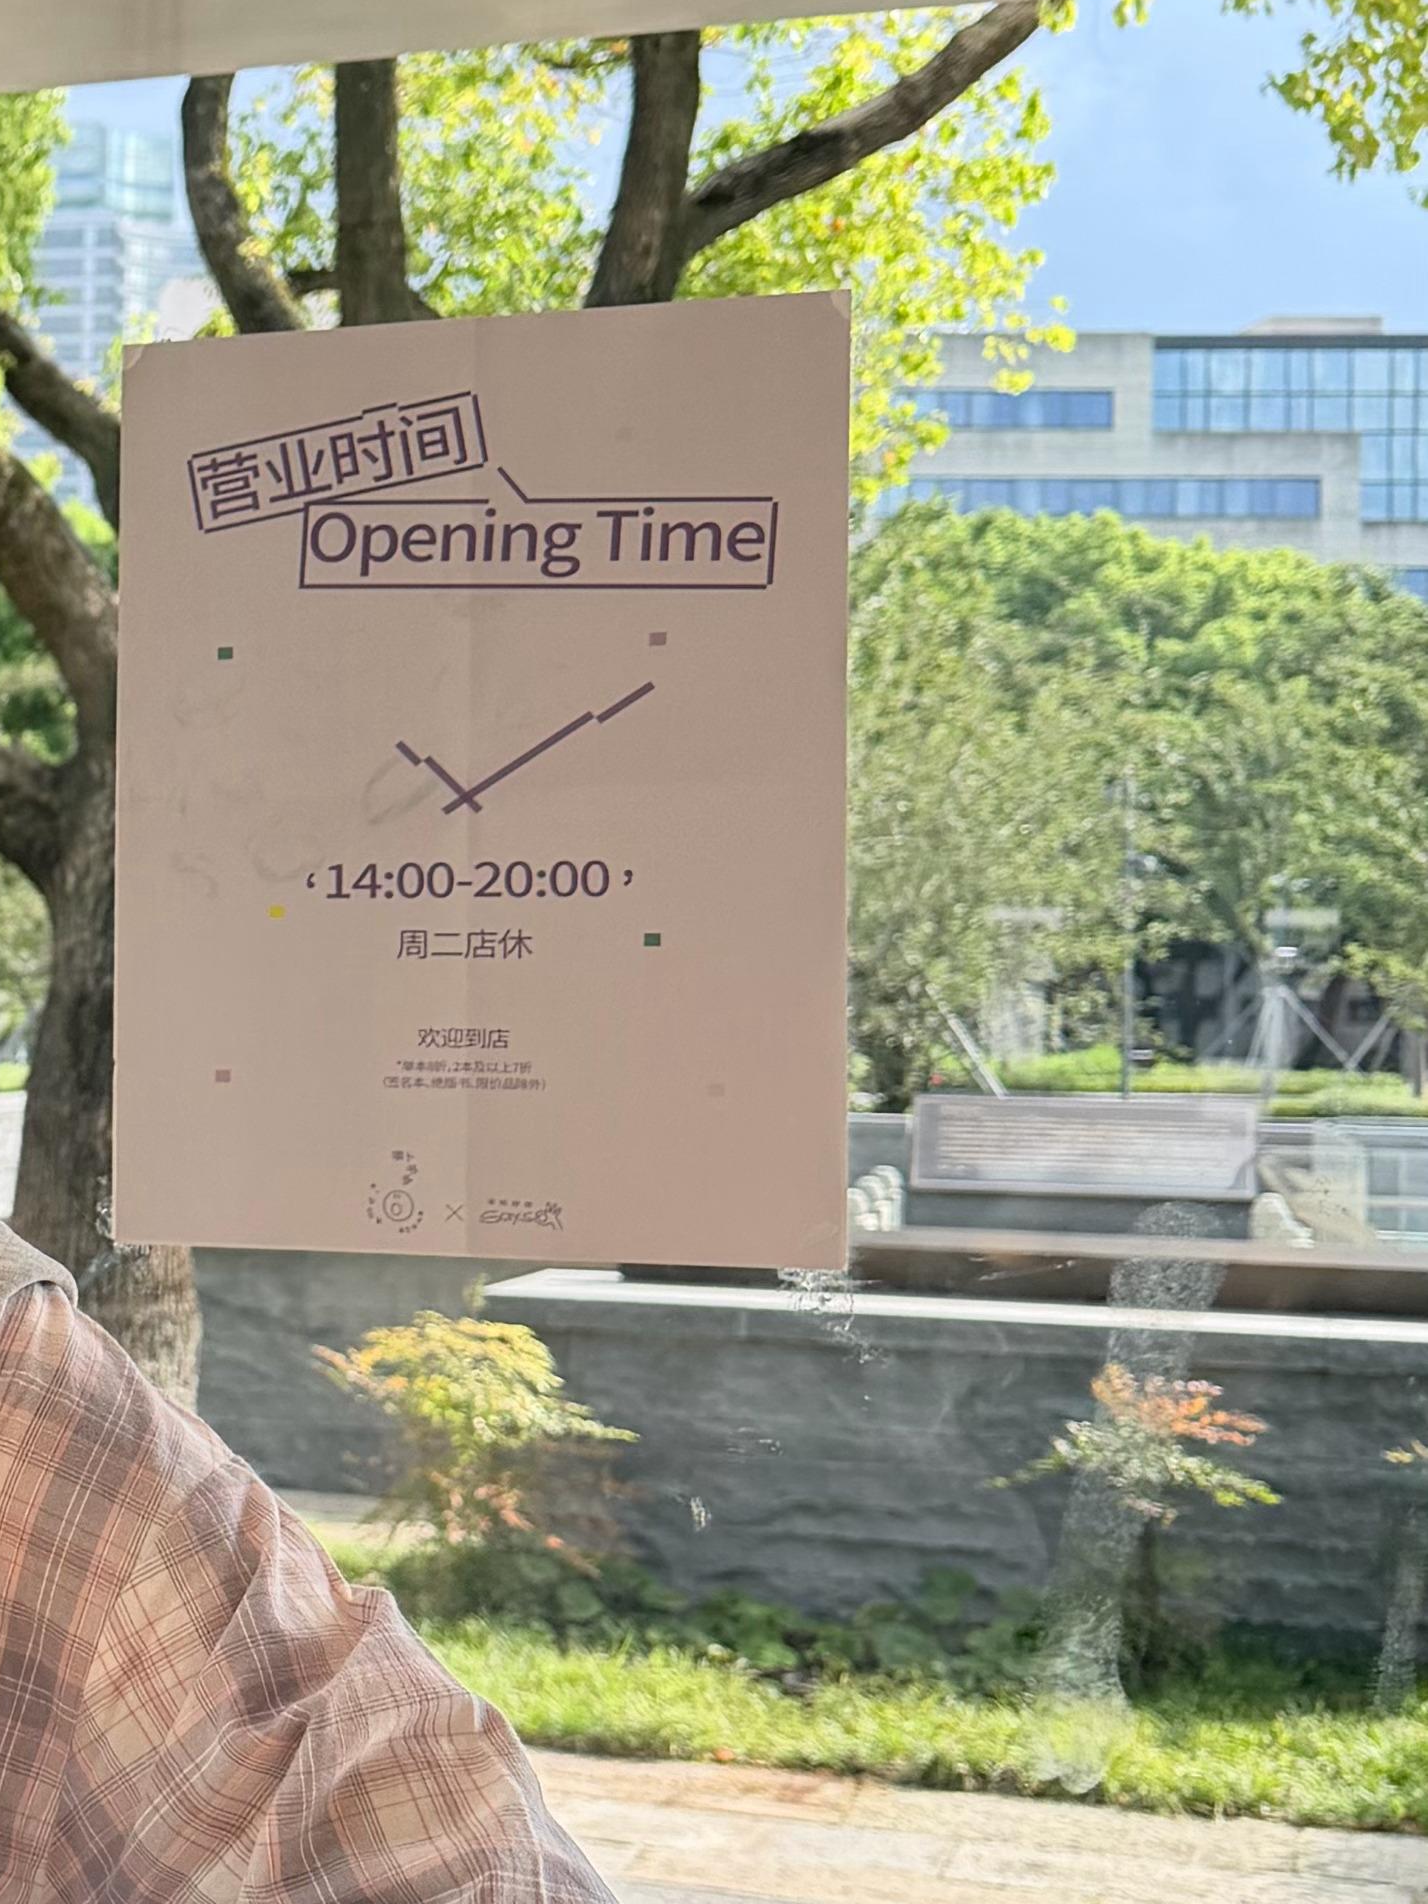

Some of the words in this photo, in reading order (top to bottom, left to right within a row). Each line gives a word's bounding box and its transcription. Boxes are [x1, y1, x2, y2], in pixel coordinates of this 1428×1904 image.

[197, 406, 469, 520] 营业时间
[310, 507, 583, 579] Opening
[596, 506, 766, 563] Time
[396, 928, 534, 960] 周二店休
[417, 1027, 511, 1049] 欢迎到店
